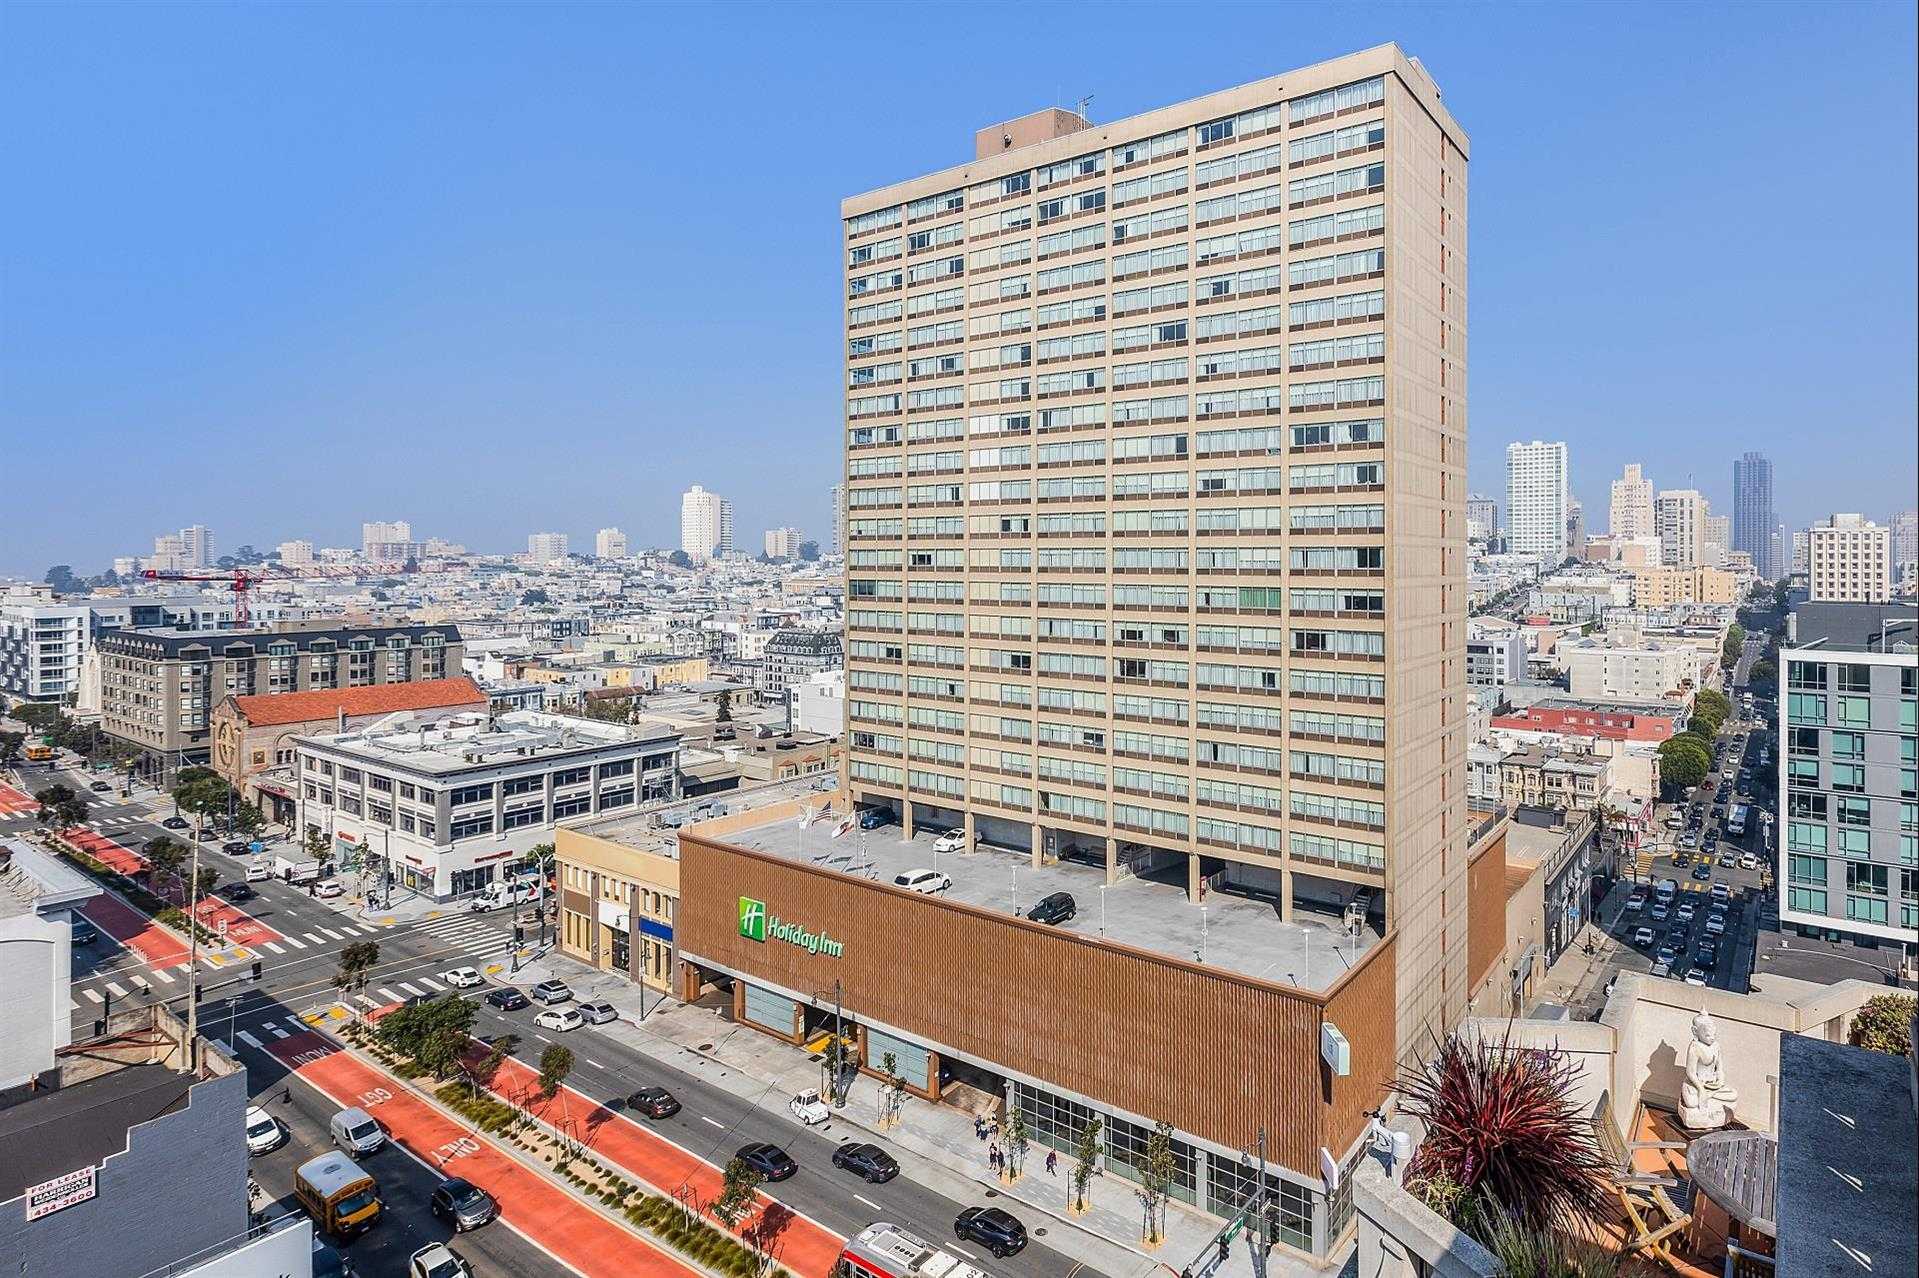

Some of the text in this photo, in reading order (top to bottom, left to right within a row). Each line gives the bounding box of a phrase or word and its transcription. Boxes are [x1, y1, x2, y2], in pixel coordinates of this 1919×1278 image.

[767, 915, 844, 958] Holiday Inn
[291, 1046, 335, 1066] MUNI
[430, 1137, 480, 1167] ONLY
[31, 1182, 53, 1194] FOR
[57, 1168, 91, 1185] LEASE
